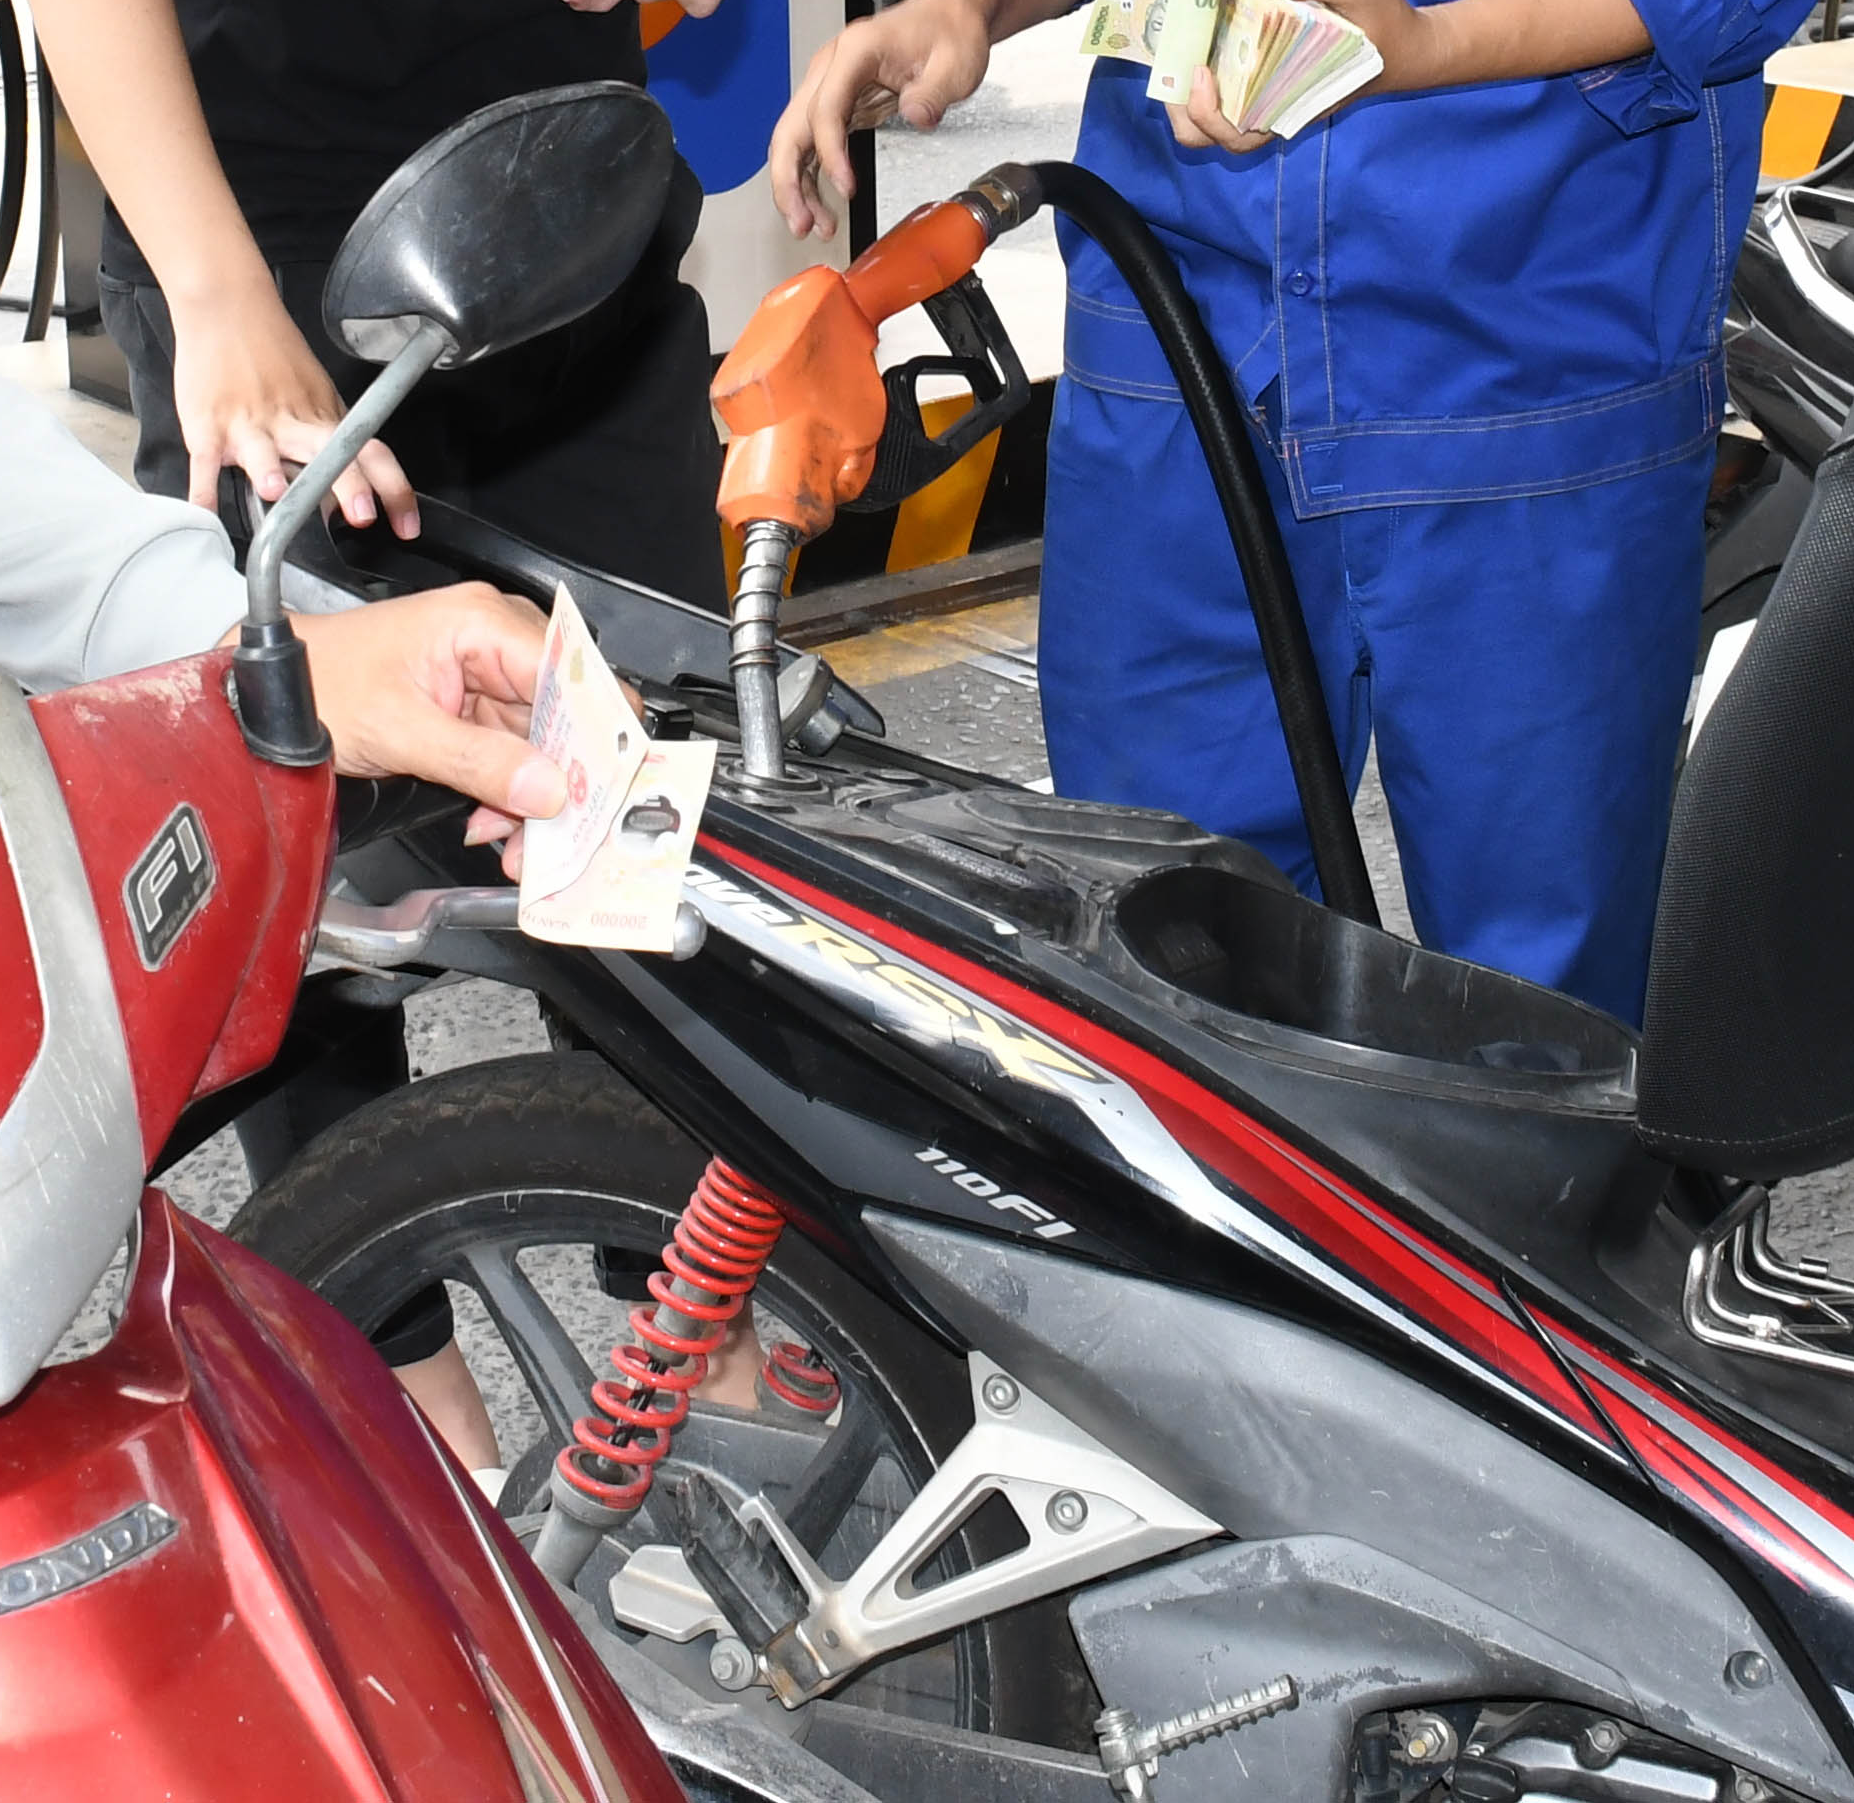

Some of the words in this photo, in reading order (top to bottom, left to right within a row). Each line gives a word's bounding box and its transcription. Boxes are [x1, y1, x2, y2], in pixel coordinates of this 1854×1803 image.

[137, 816, 202, 933] FI
[683, 863, 793, 925] ave
[774, 914, 1114, 1093] RSX
[914, 1146, 1077, 1238] 110FI
